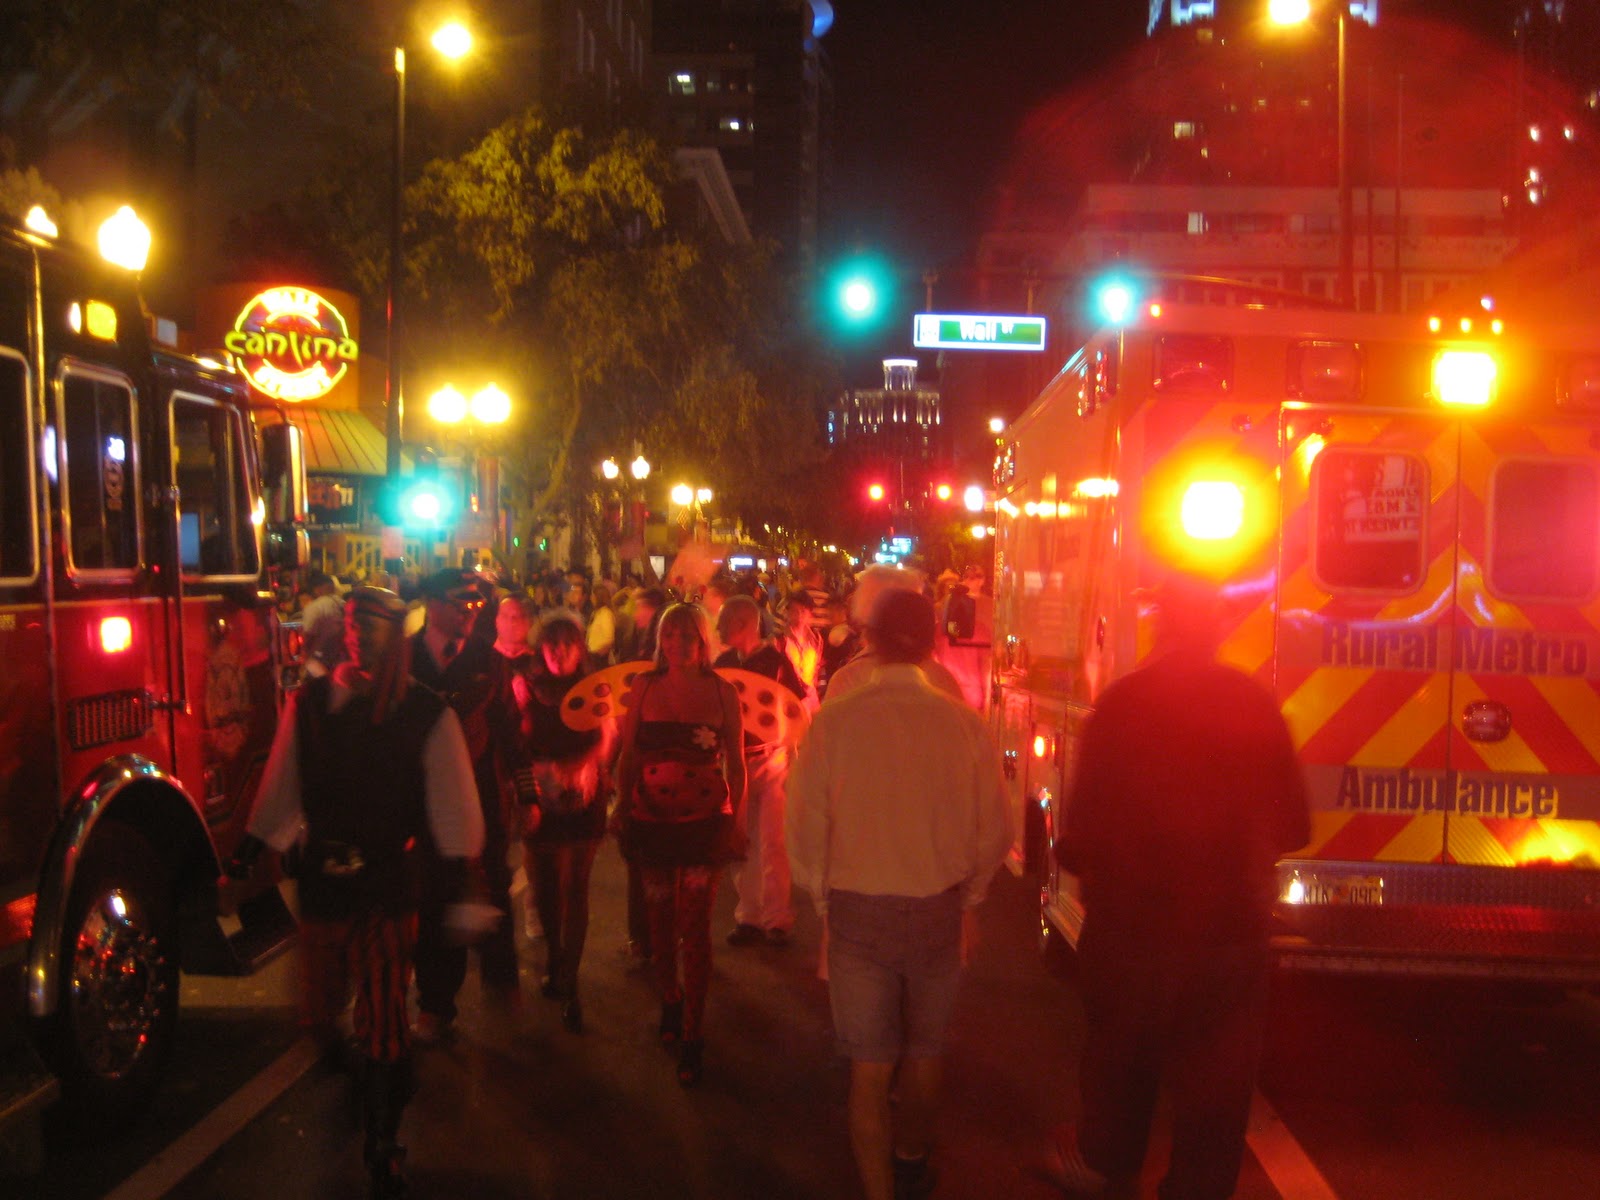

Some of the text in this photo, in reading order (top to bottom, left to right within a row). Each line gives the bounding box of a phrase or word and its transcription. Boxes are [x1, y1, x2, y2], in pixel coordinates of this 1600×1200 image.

[225, 330, 359, 366] cantina
[960, 320, 997, 341] Wall
[1322, 623, 1588, 675] Rural Metro
[1337, 767, 1557, 816] Ambulance
